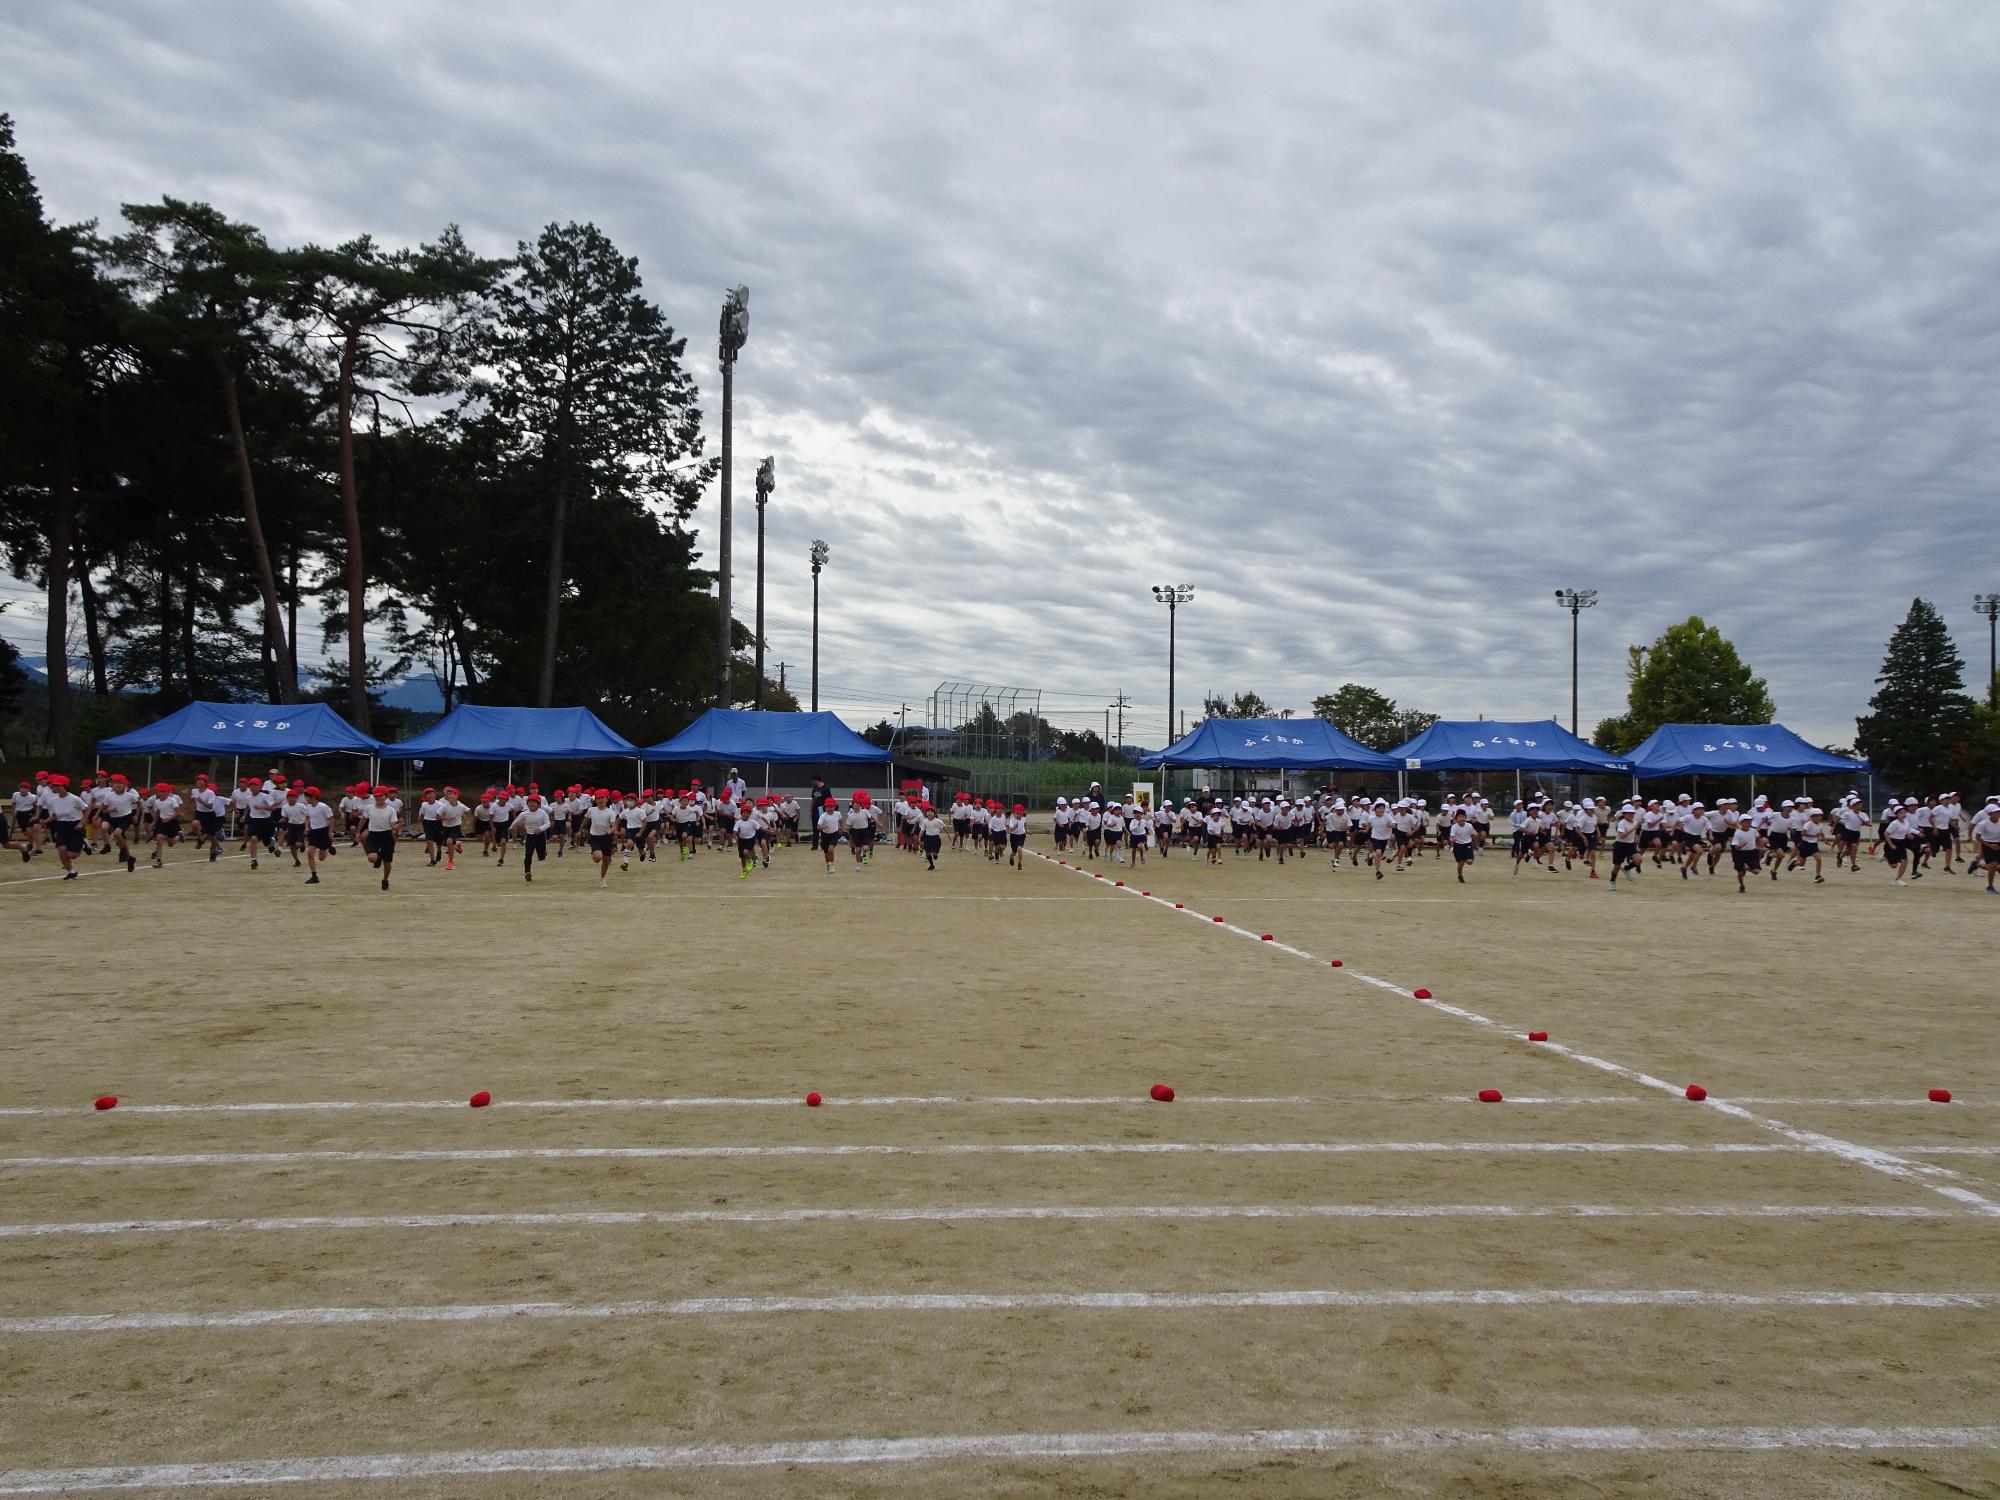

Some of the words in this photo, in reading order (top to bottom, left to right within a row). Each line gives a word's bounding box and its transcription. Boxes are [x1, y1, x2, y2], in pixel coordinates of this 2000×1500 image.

[212, 720, 291, 730] ふくおか
[1244, 735, 1304, 747] ふくおか
[1473, 737, 1537, 748] ふくおか
[1704, 740, 1769, 752] ふくおか
